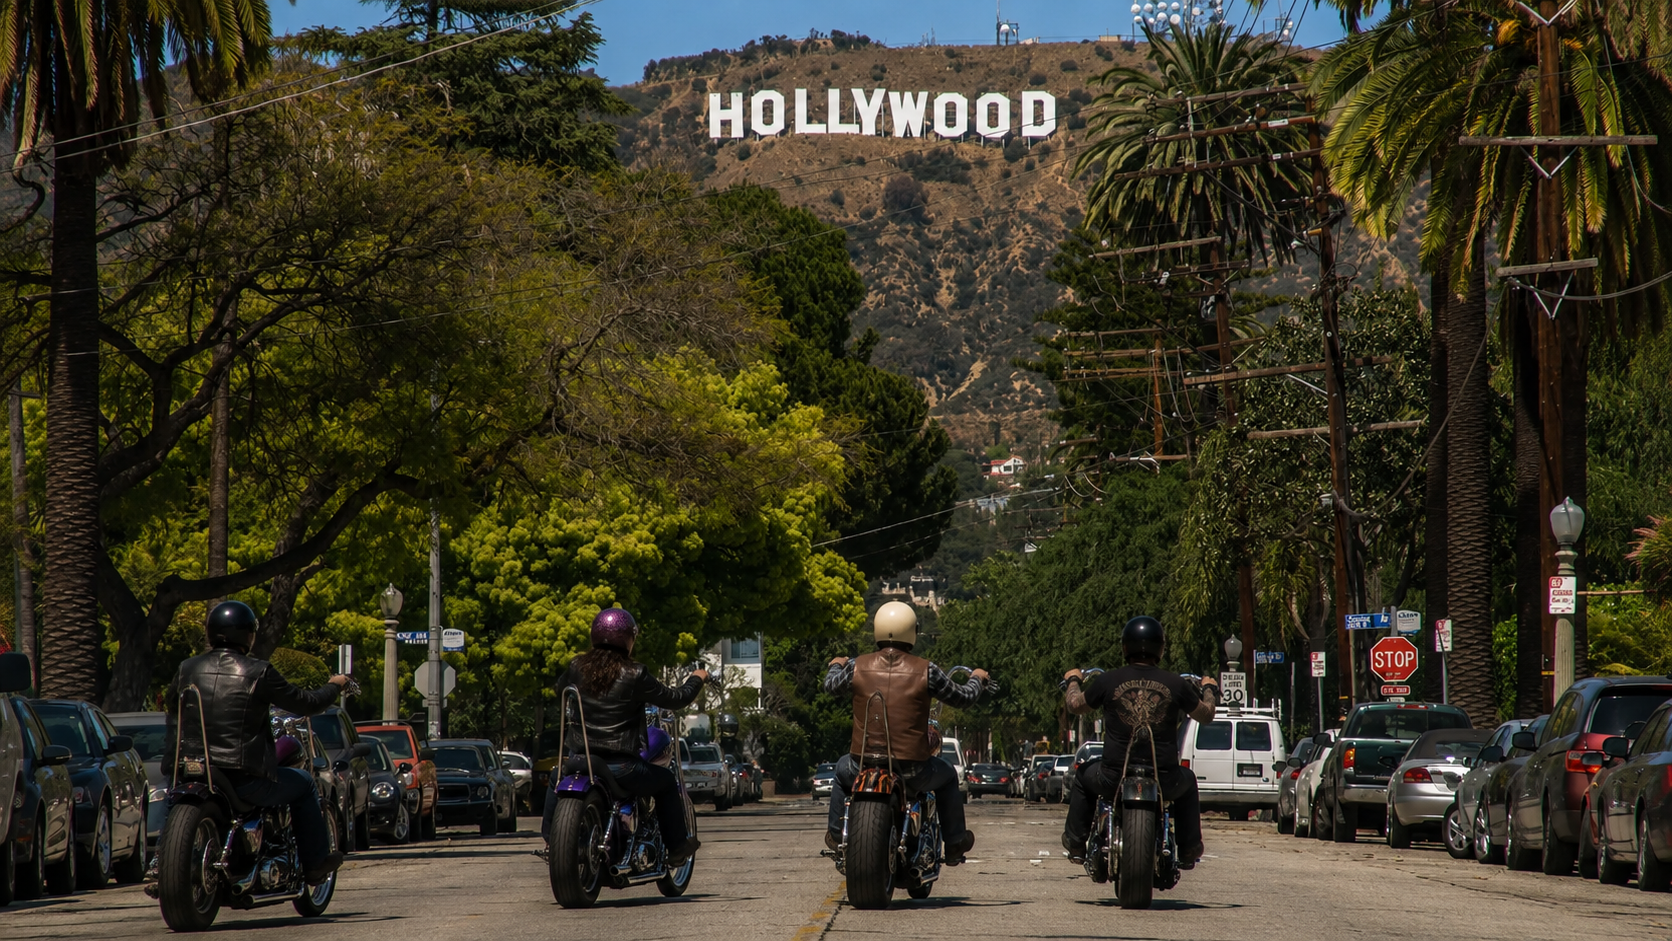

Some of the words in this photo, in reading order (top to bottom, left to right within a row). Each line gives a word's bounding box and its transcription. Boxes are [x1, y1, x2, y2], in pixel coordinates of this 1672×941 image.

[709, 88, 1056, 138] HOLLYWOOD
[1375, 651, 1414, 668] STOP
[1223, 689, 1243, 702] 30
